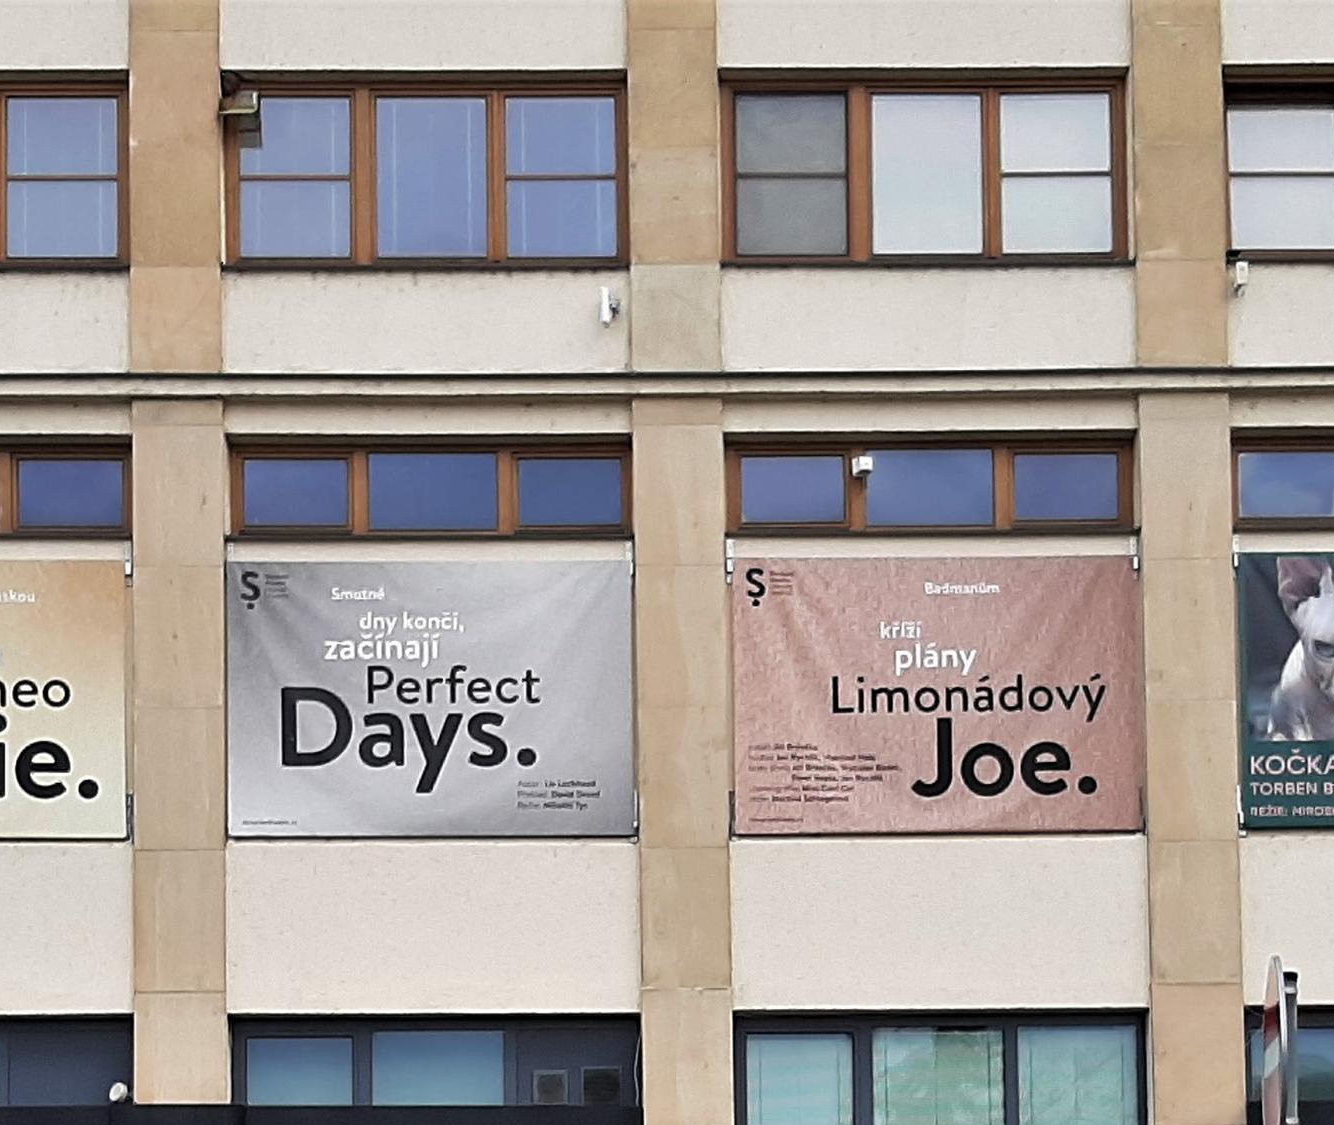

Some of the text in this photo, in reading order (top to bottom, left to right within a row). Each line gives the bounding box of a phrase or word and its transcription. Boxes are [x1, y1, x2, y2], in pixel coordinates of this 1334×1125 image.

[359, 612, 397, 635] dny
[324, 634, 440, 668] začínají
[894, 642, 977, 676] plány
[367, 665, 541, 704] Perfect
[831, 673, 1106, 723] Limonádový
[281, 686, 537, 794] Days.
[910, 717, 1099, 798] Joe.
[1250, 781, 1318, 796] TORBEN
